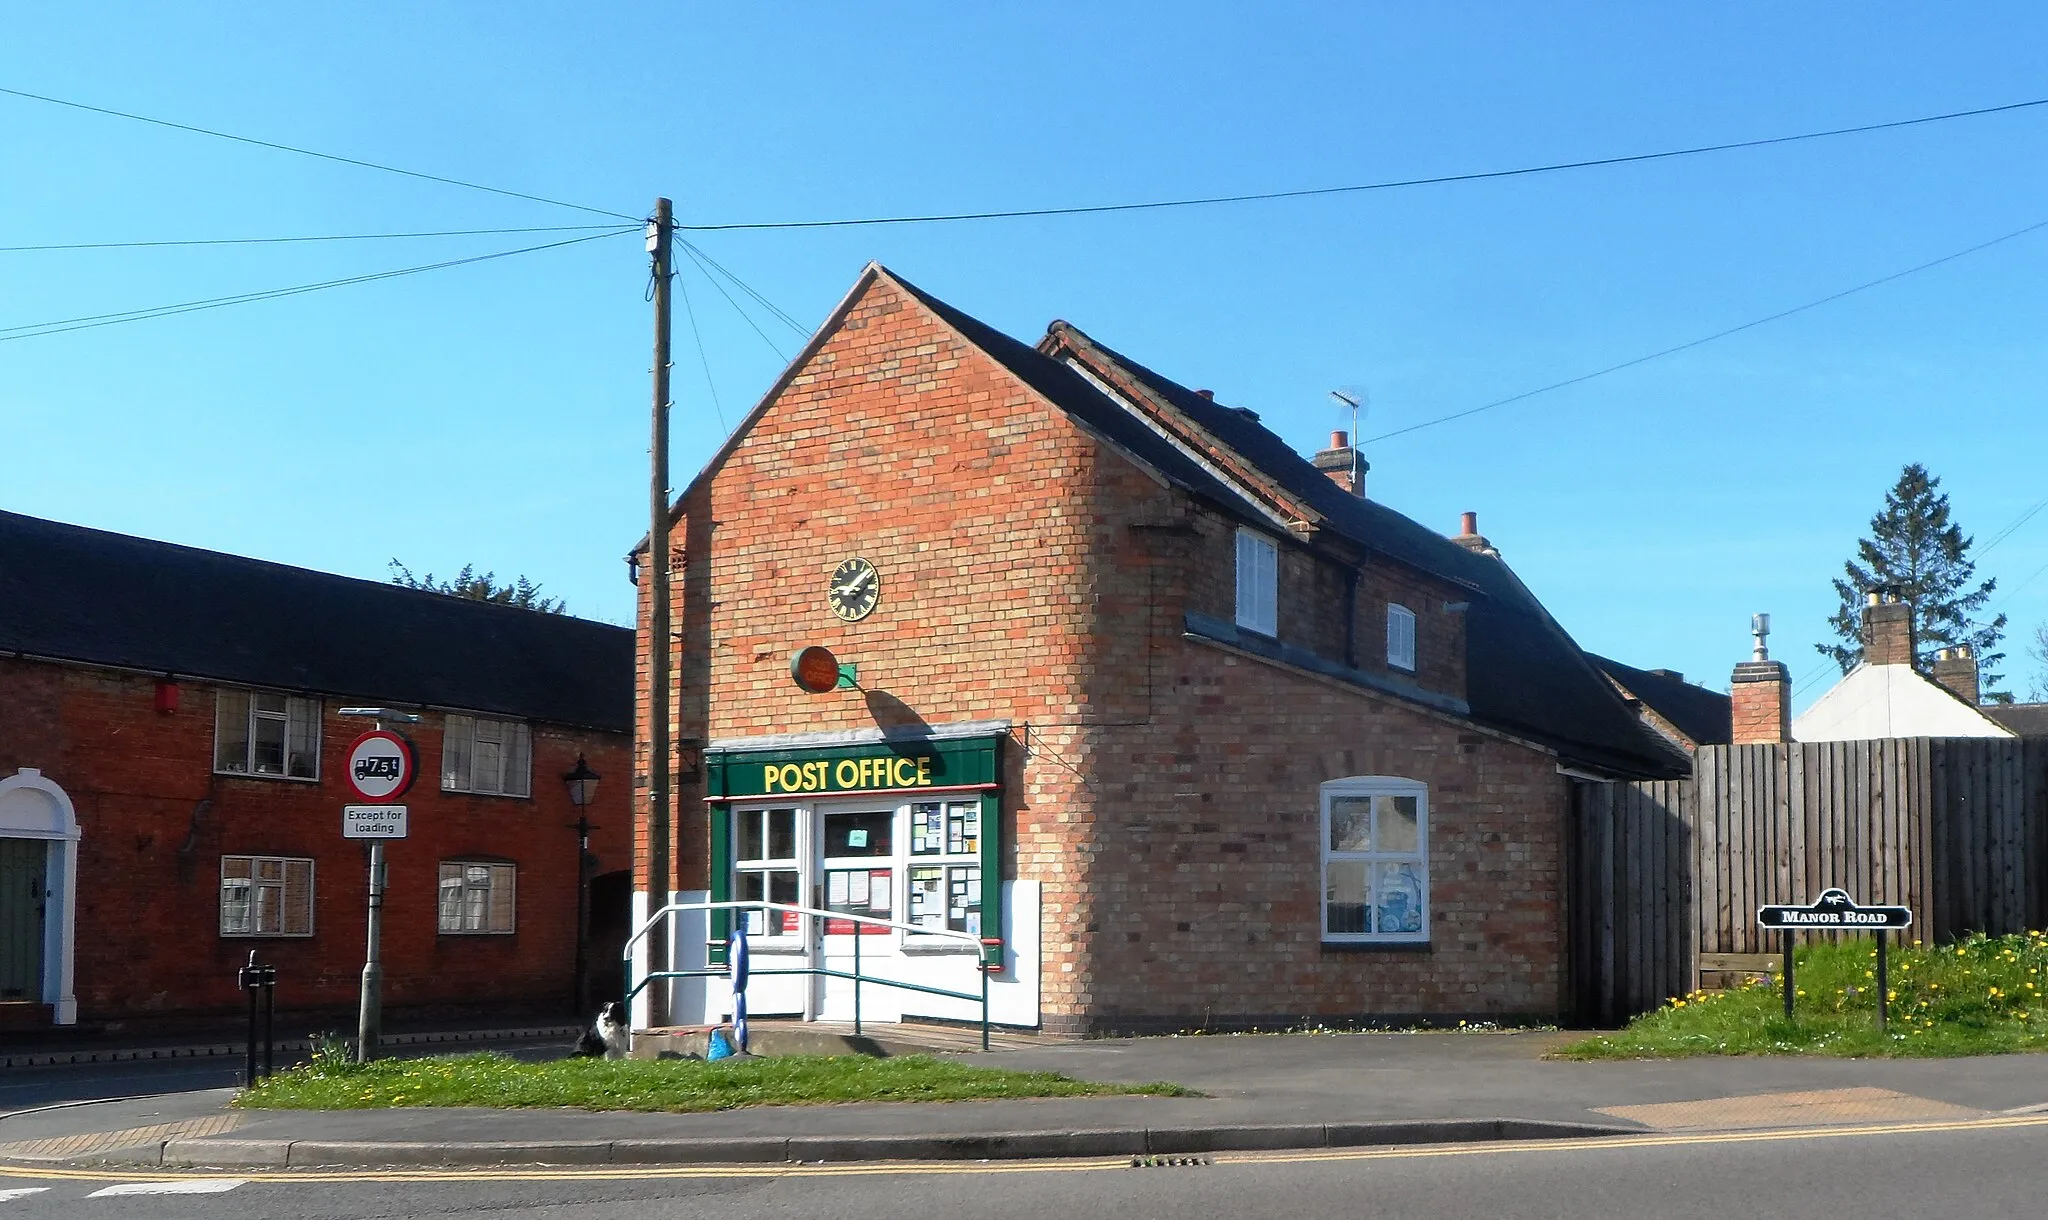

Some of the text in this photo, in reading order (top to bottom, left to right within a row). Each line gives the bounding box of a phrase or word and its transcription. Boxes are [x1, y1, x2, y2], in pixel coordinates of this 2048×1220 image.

[369, 758, 389, 773] 7.5
[764, 756, 931, 793] POST OFFICE
[348, 810, 402, 821] Except for
[355, 822, 394, 834] loading
[1782, 911, 1888, 923] MANOR ROAD
